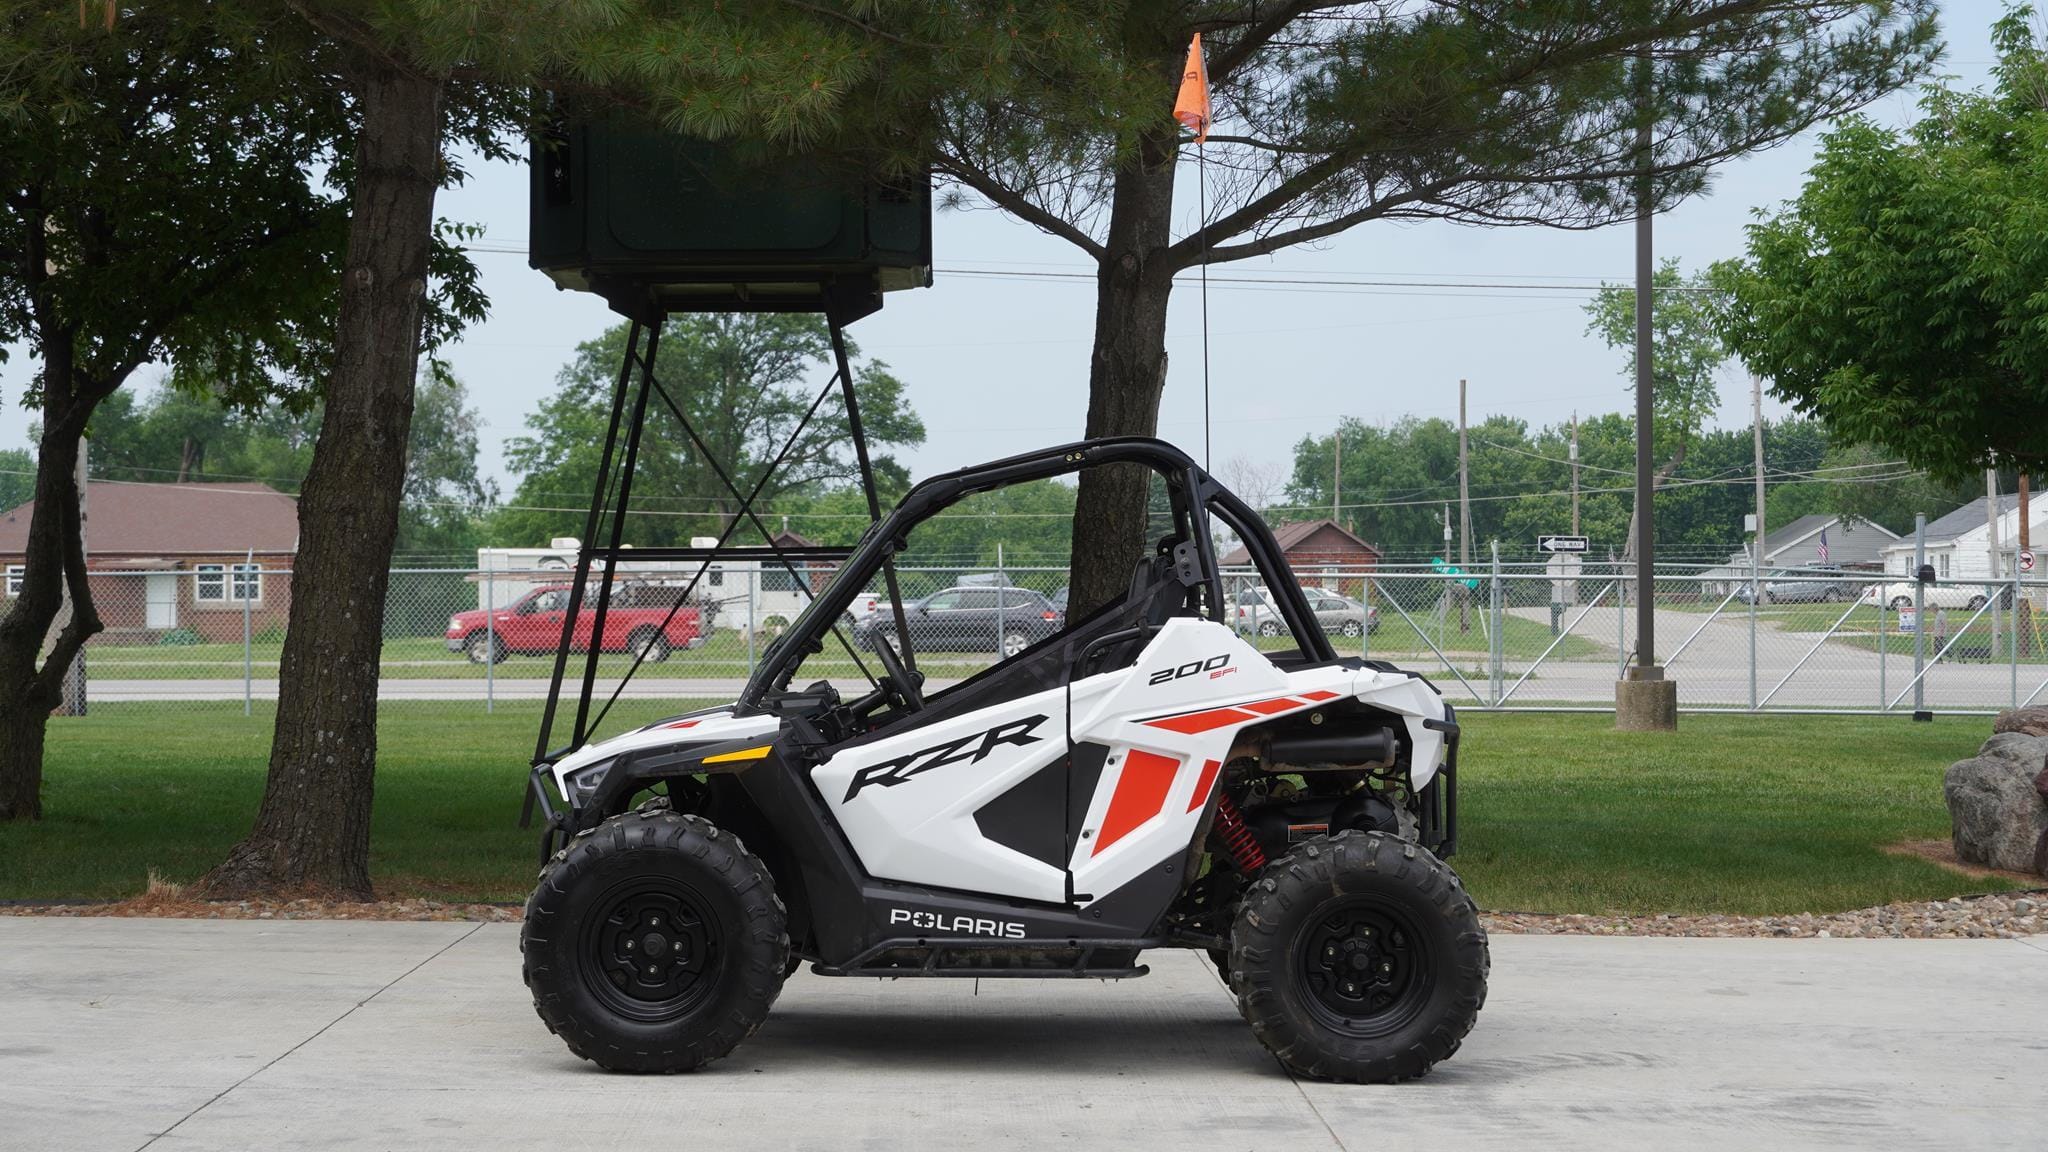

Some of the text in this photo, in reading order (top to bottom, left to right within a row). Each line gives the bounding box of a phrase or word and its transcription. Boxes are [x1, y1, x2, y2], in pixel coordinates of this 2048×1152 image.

[1149, 653, 1230, 686] 200
[1209, 667, 1238, 680] EFI
[842, 713, 1050, 805] RZR
[890, 908, 1026, 939] POLARIS
